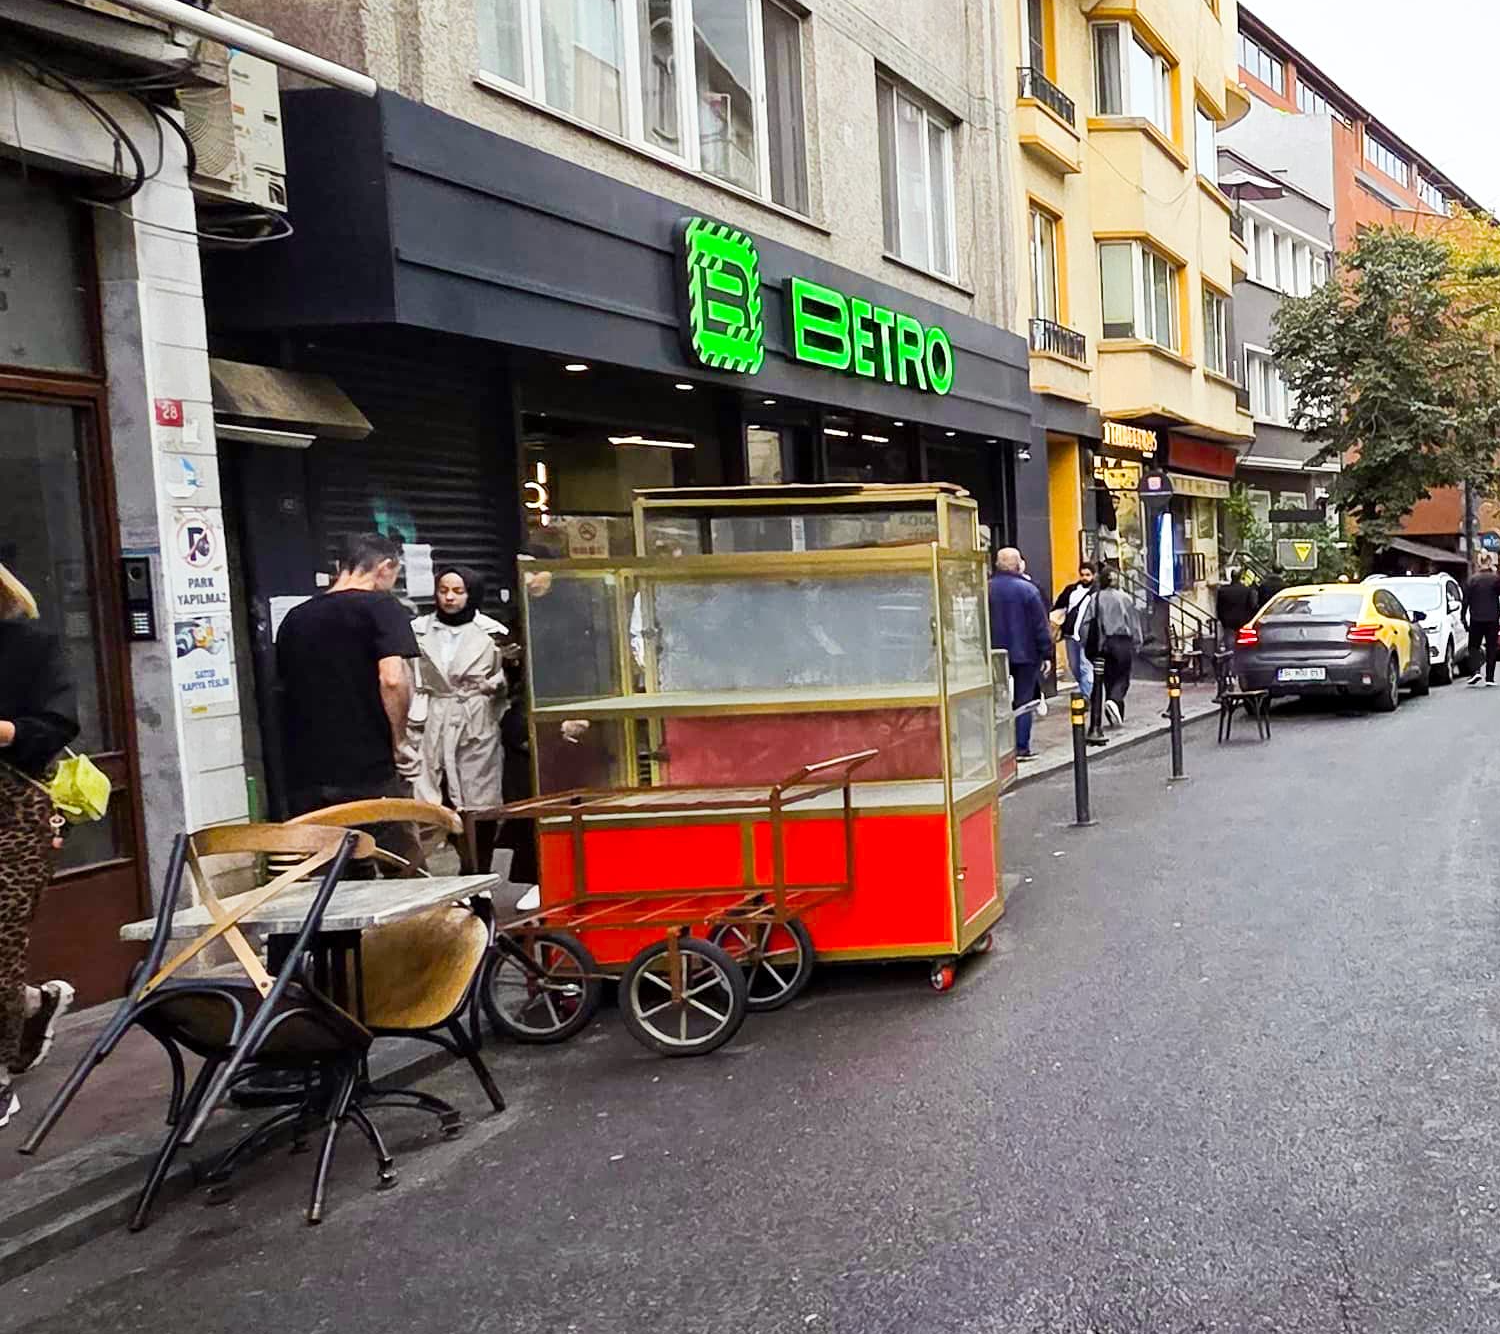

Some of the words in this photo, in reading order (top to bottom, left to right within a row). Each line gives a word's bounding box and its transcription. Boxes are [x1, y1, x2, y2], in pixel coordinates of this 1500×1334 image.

[791, 276, 954, 396] BETRO
[162, 406, 178, 420] 28
[188, 577, 214, 588] PARK
[177, 591, 228, 605] YAPILMAZ
